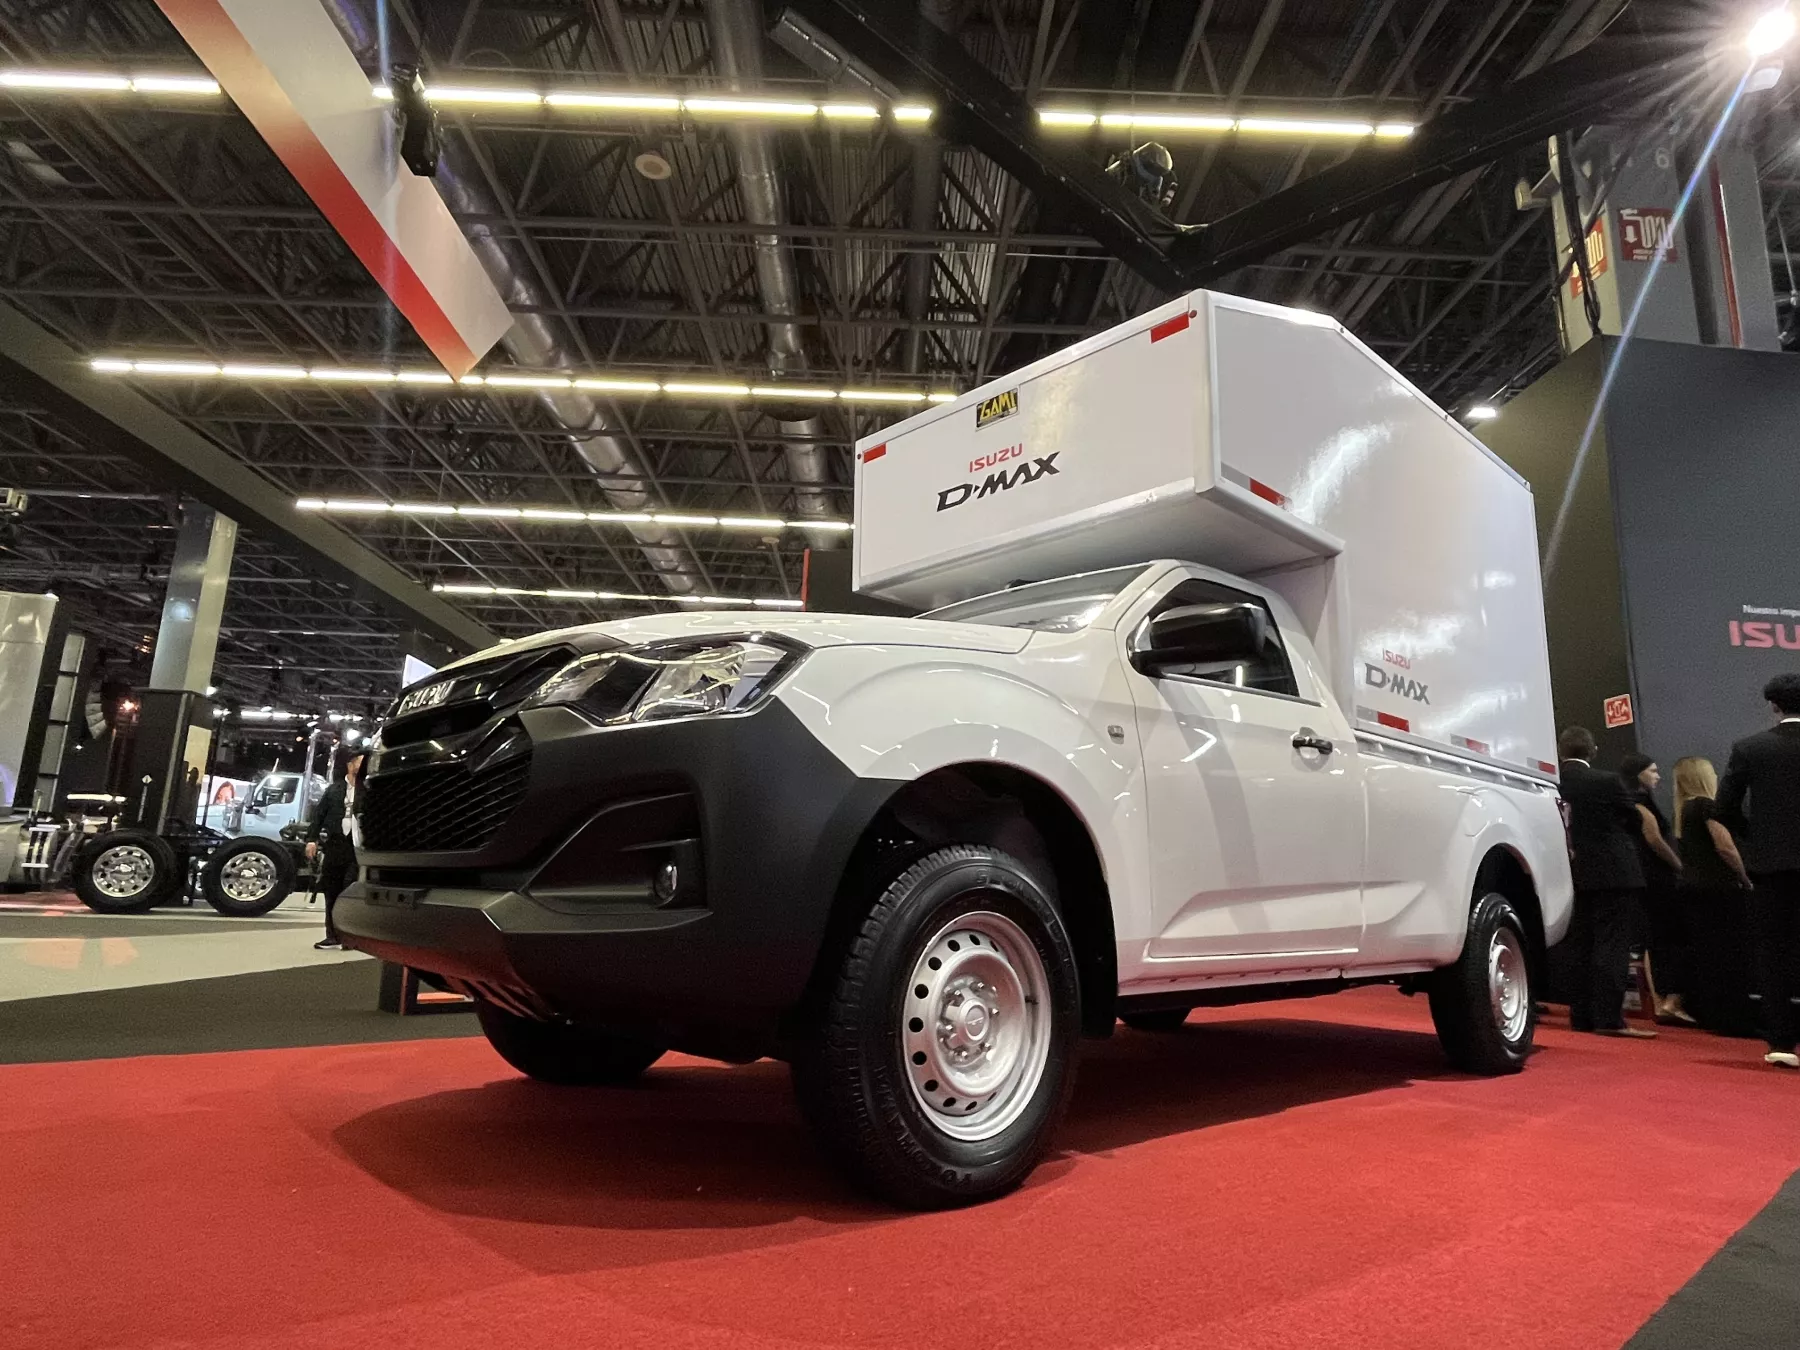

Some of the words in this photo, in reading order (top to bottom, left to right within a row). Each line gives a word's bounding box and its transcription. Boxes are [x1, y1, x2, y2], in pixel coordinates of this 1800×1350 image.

[968, 442, 1024, 473] ISUZU
[1728, 620, 1800, 650] ISU
[1382, 648, 1411, 670] ISUZU
